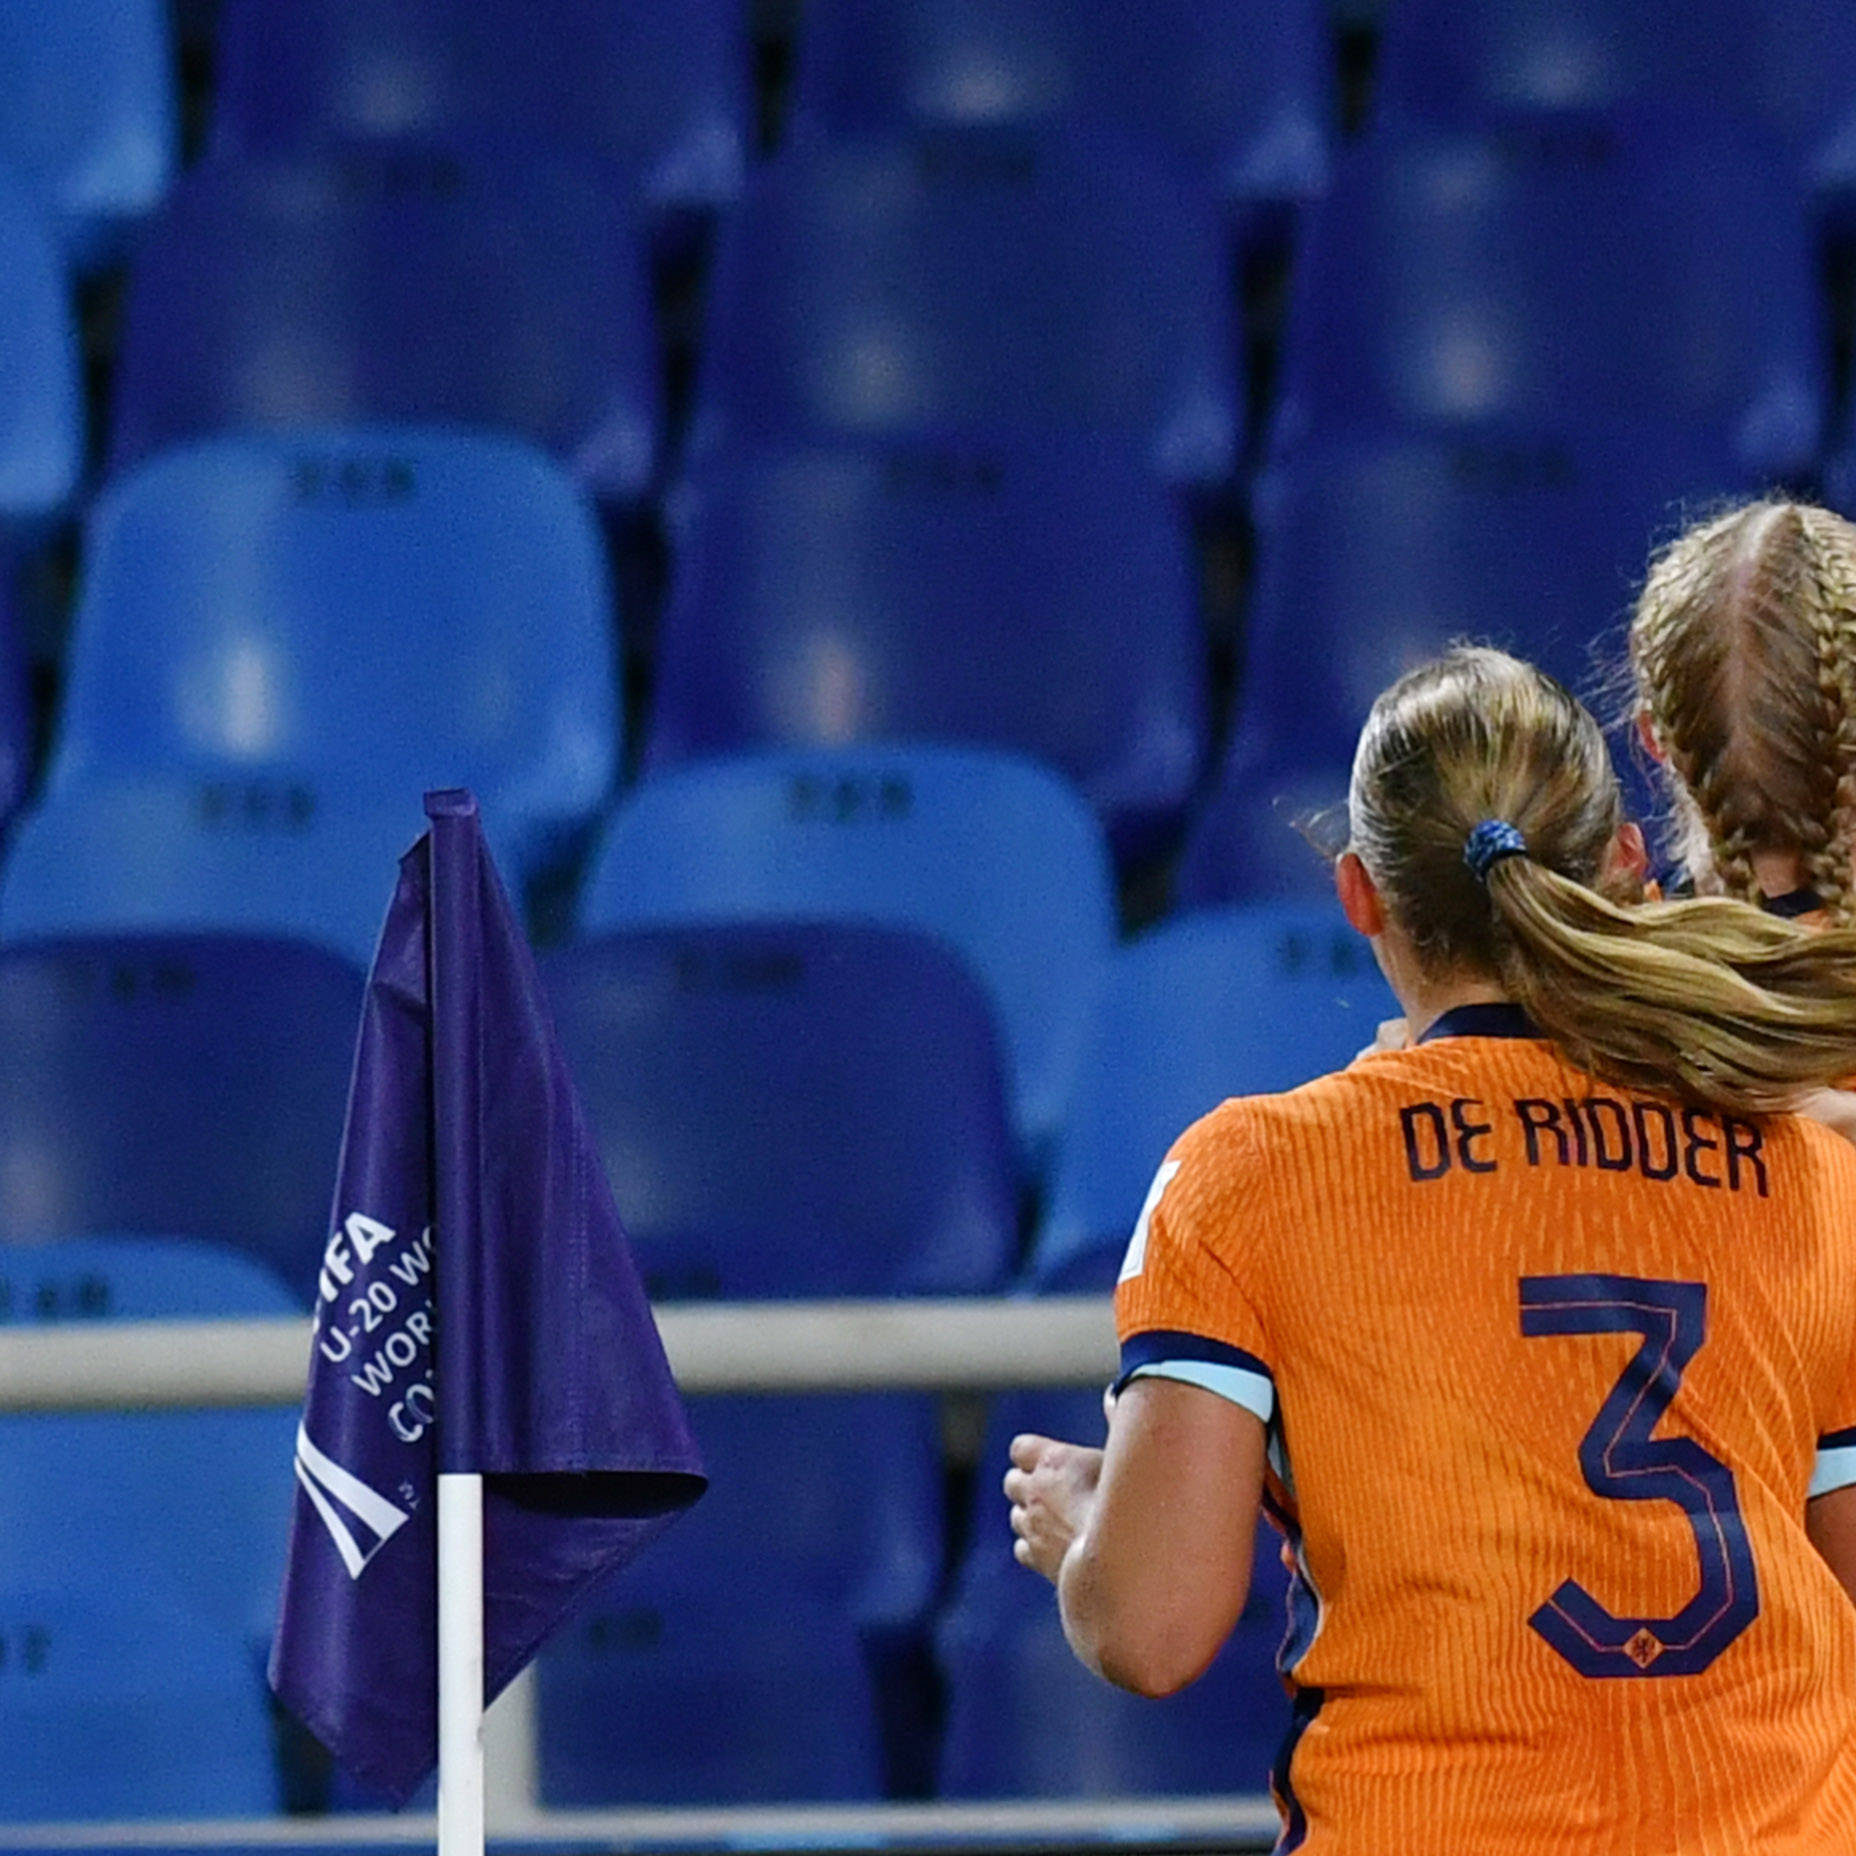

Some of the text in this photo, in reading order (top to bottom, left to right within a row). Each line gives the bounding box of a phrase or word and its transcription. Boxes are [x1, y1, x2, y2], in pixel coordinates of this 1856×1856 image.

[1401, 1097, 1770, 1198] DE RIDDER
[313, 1211, 396, 1333] IFA
[319, 1281, 398, 1363] U-20
[351, 1299, 434, 1397] WOR
[1518, 1273, 1760, 1679] 3
